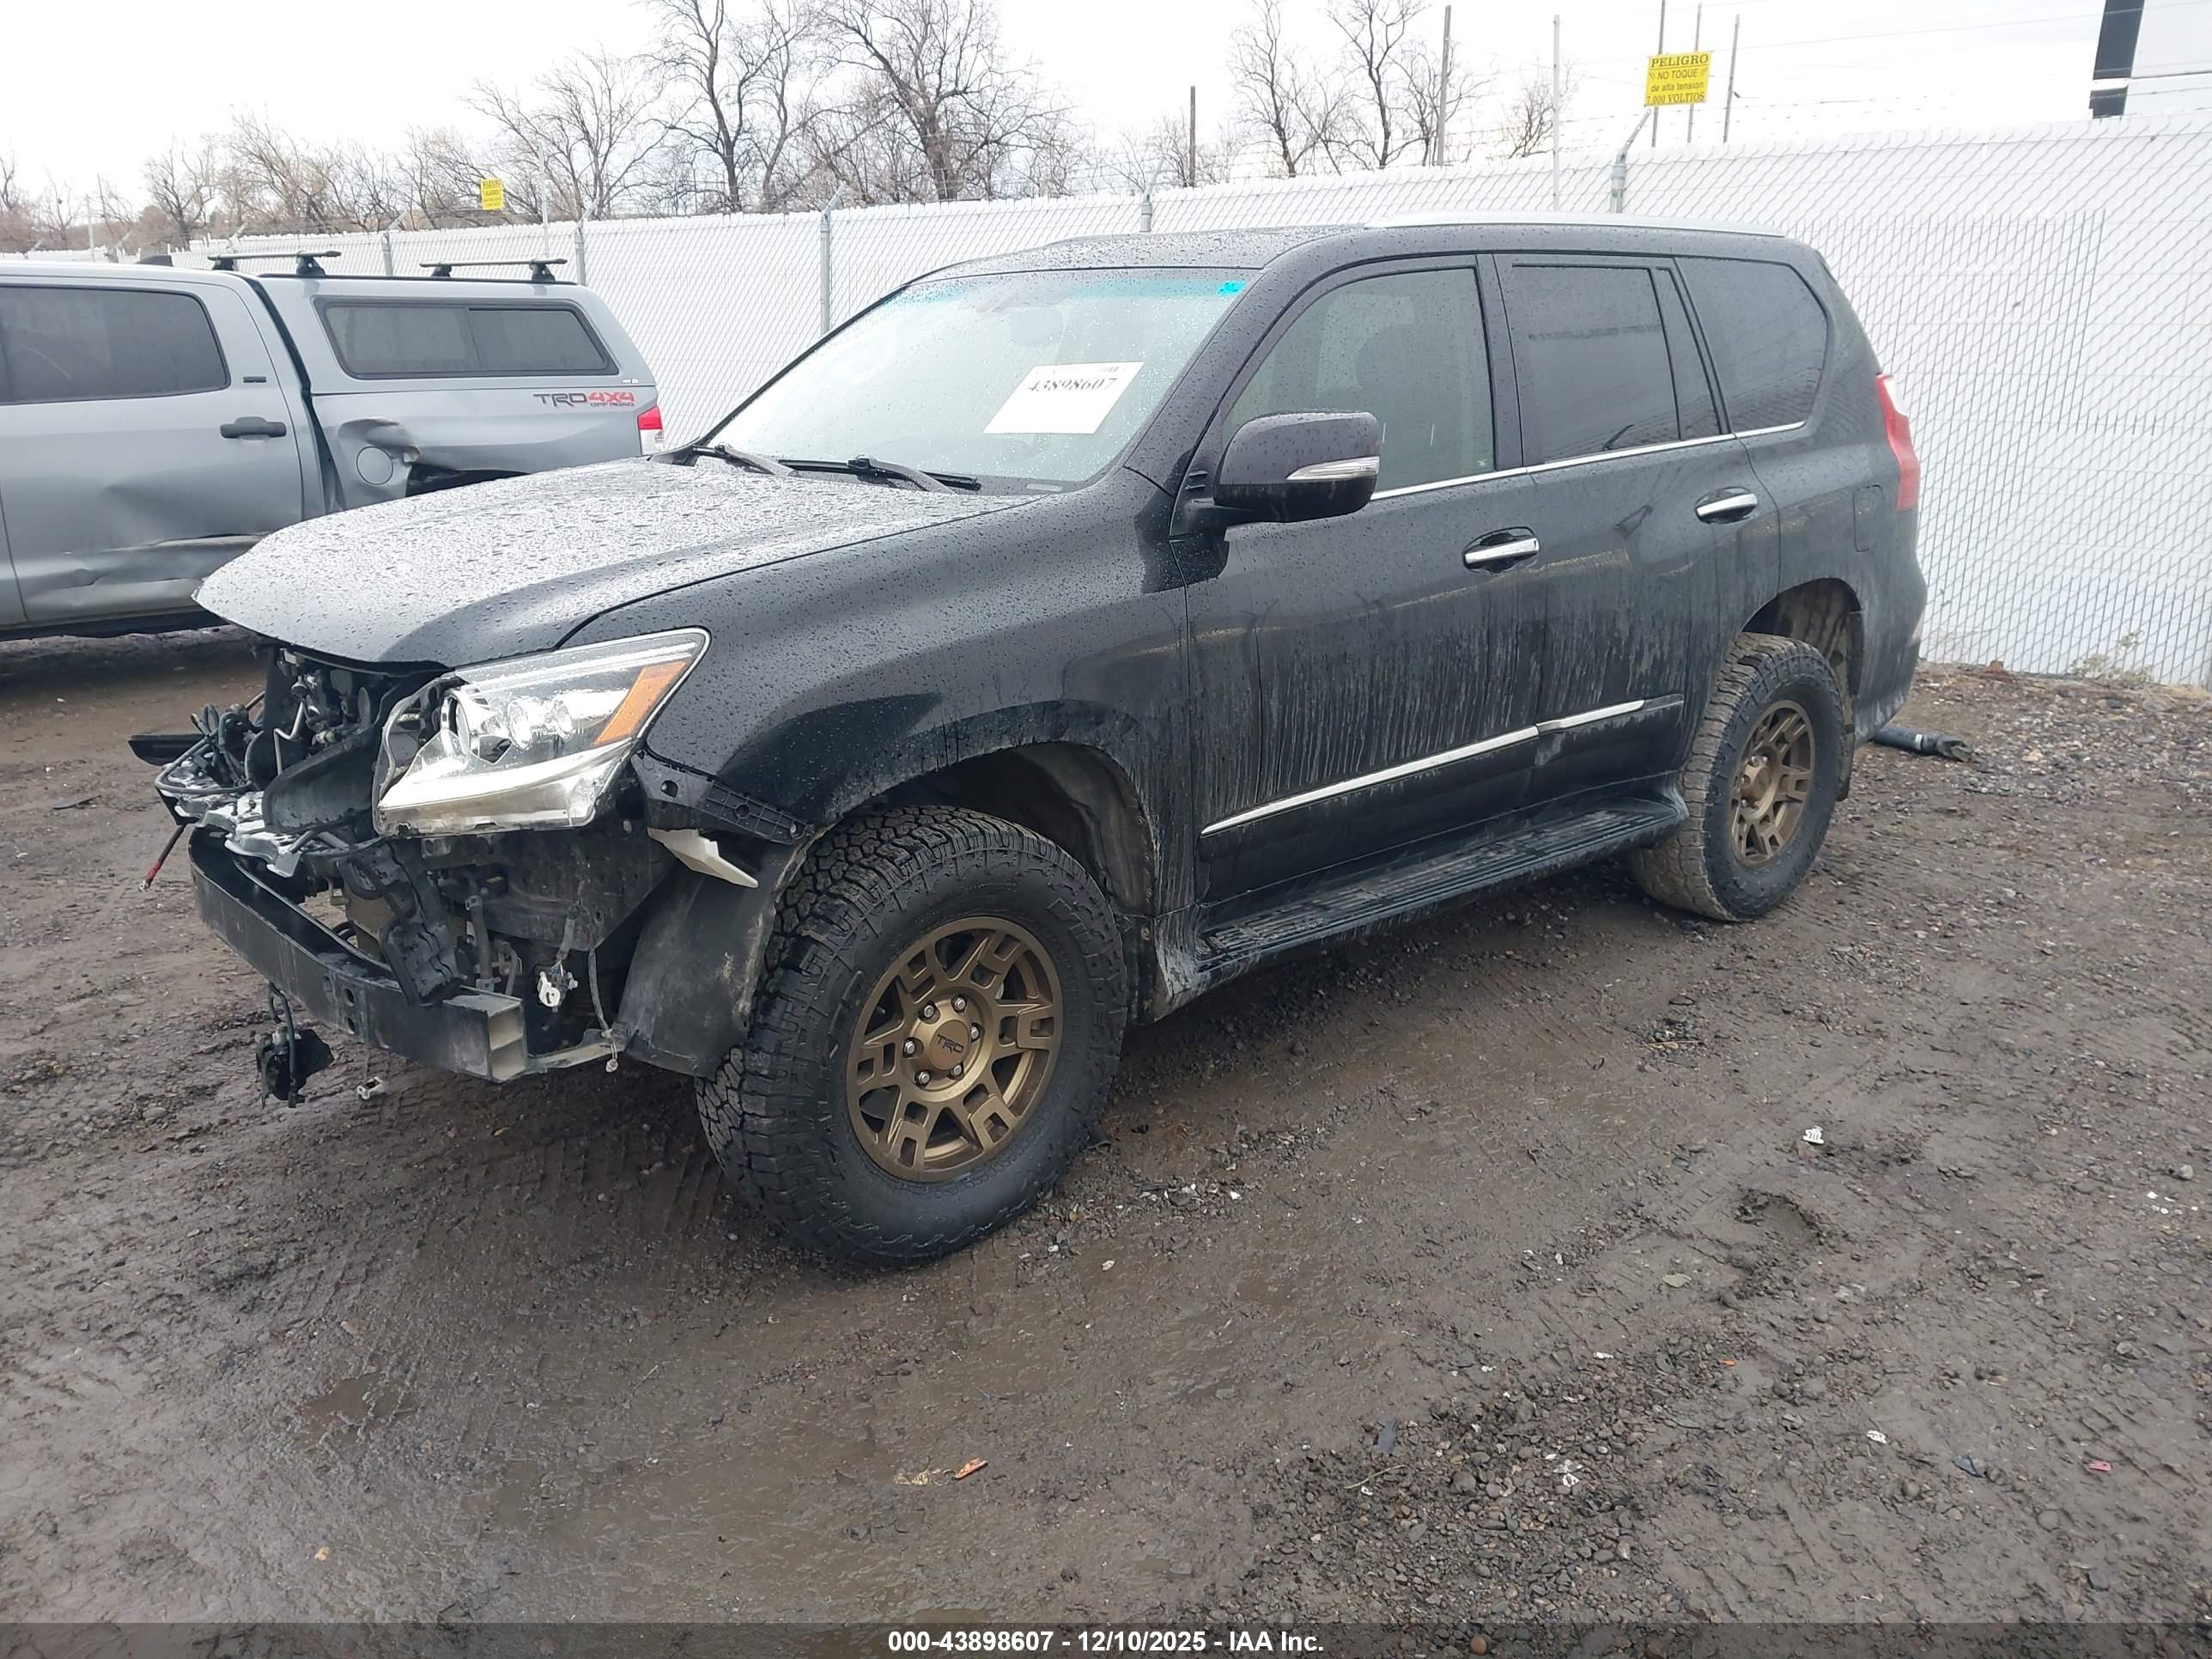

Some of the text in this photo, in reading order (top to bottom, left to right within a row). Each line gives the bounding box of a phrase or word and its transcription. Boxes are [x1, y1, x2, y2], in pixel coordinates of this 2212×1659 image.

[1651, 53, 1709, 68] PELIGRO
[1657, 69, 1698, 80] NO TOQUE
[1668, 91, 1705, 103] VOLTIOS
[1027, 377, 1118, 392] 43898607
[533, 392, 587, 407] TRD
[937, 1033, 964, 1054] TRD
